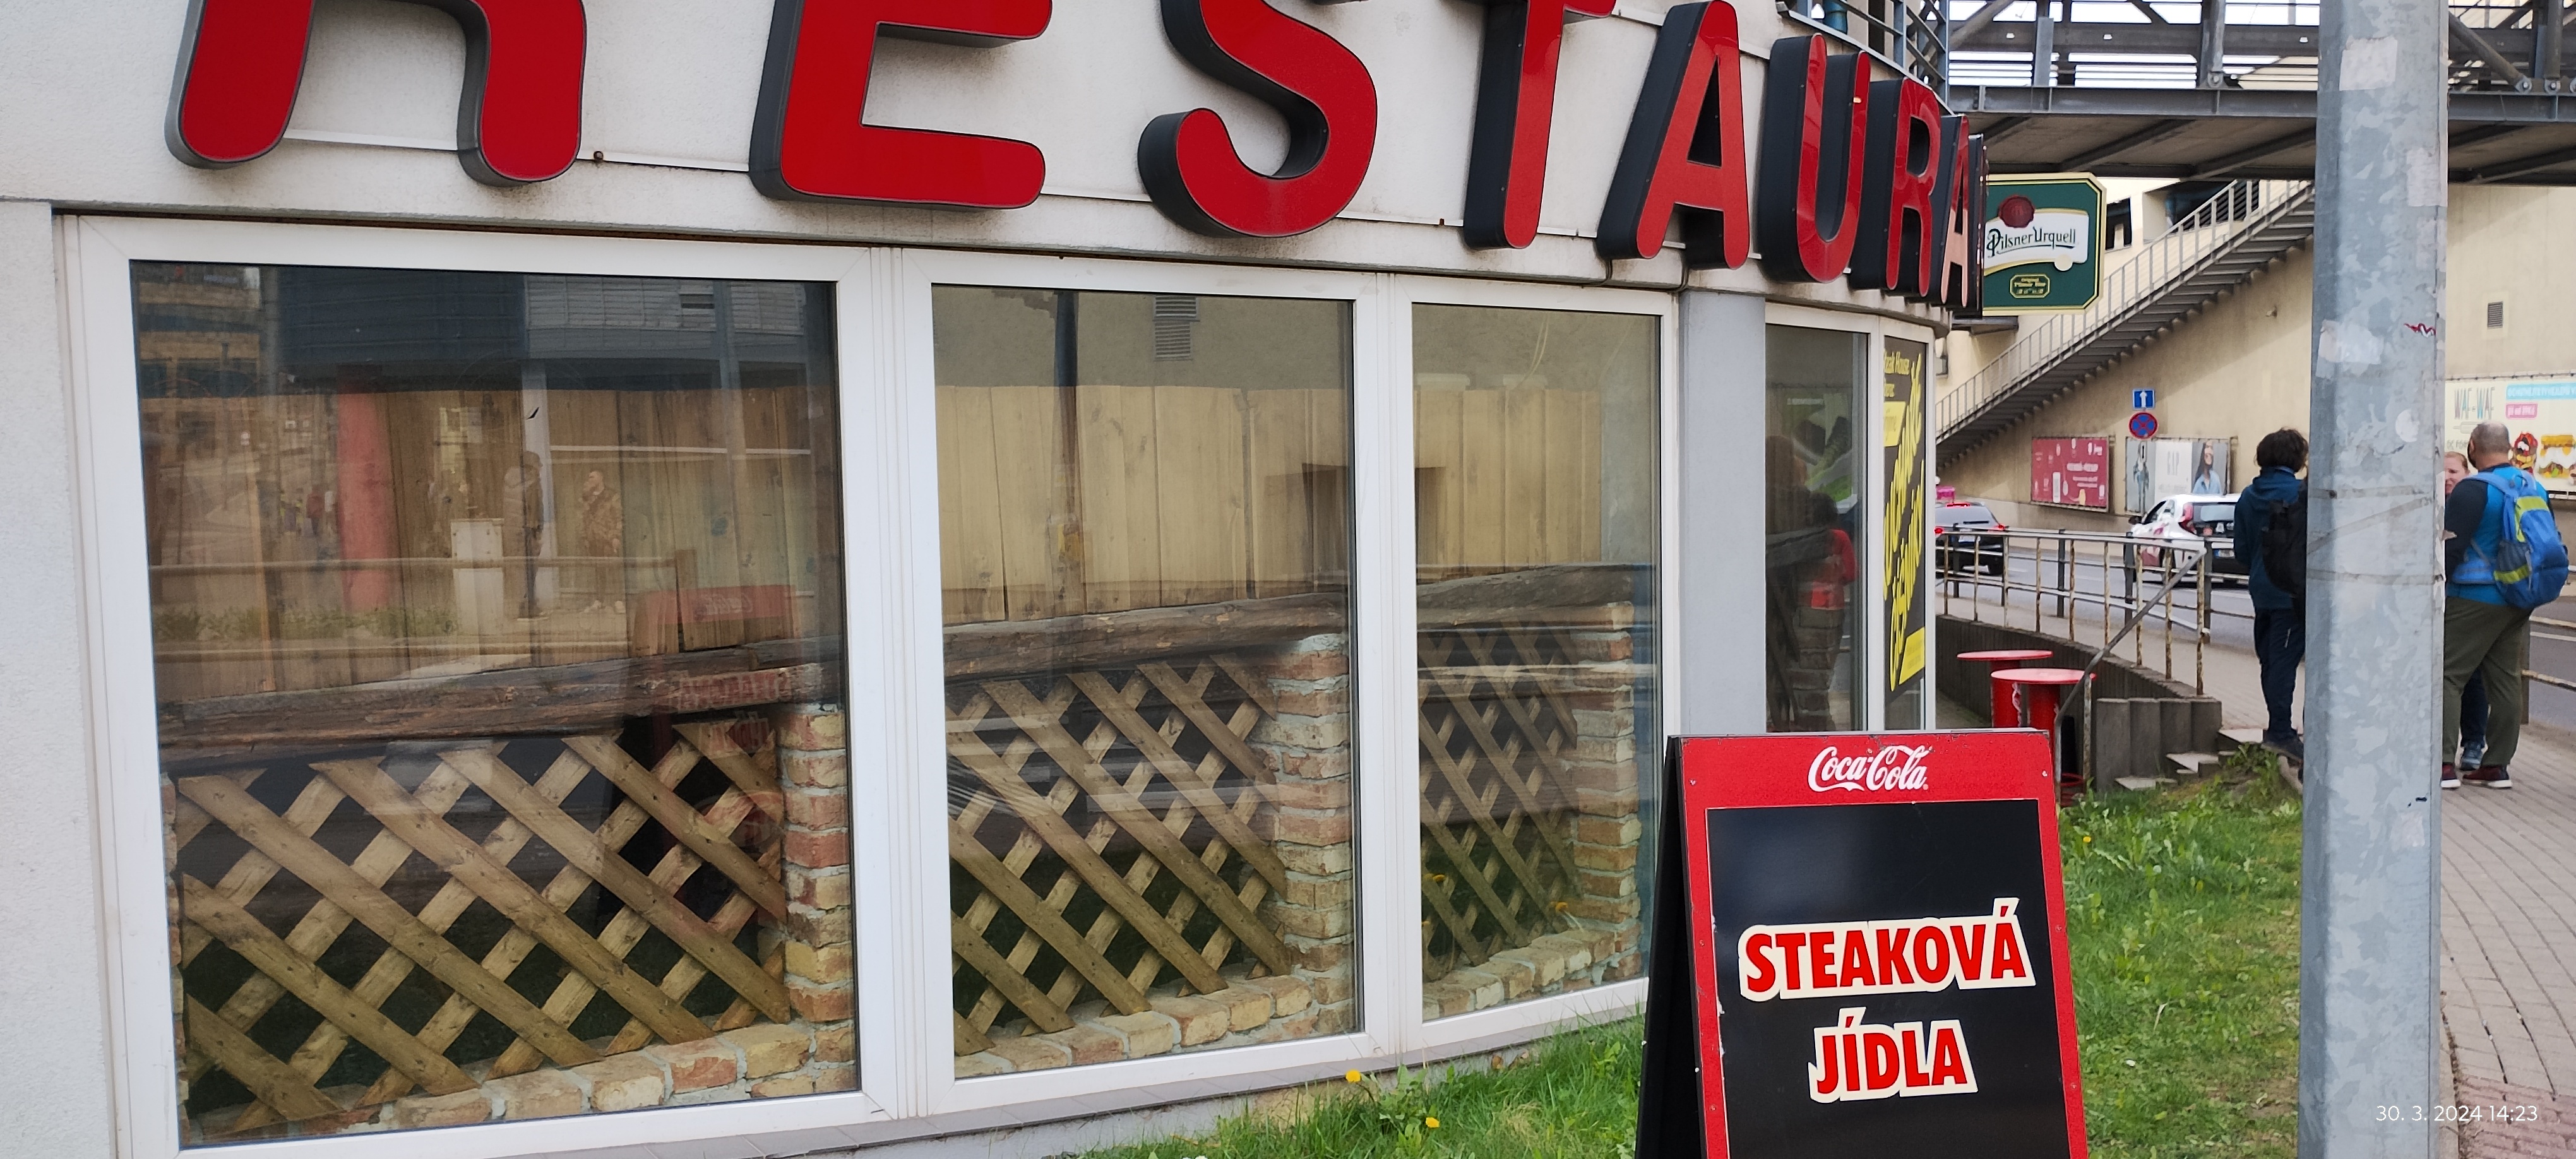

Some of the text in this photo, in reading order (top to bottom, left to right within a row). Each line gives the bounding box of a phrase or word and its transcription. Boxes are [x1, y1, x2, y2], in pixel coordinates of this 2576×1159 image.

[1986, 226, 2076, 258] Pilsner Urquell
[1808, 745, 1930, 792] Coca-Cola
[1744, 905, 2027, 994] STEAKOVÁ
[1815, 1014, 1968, 1095] JÍDLA
